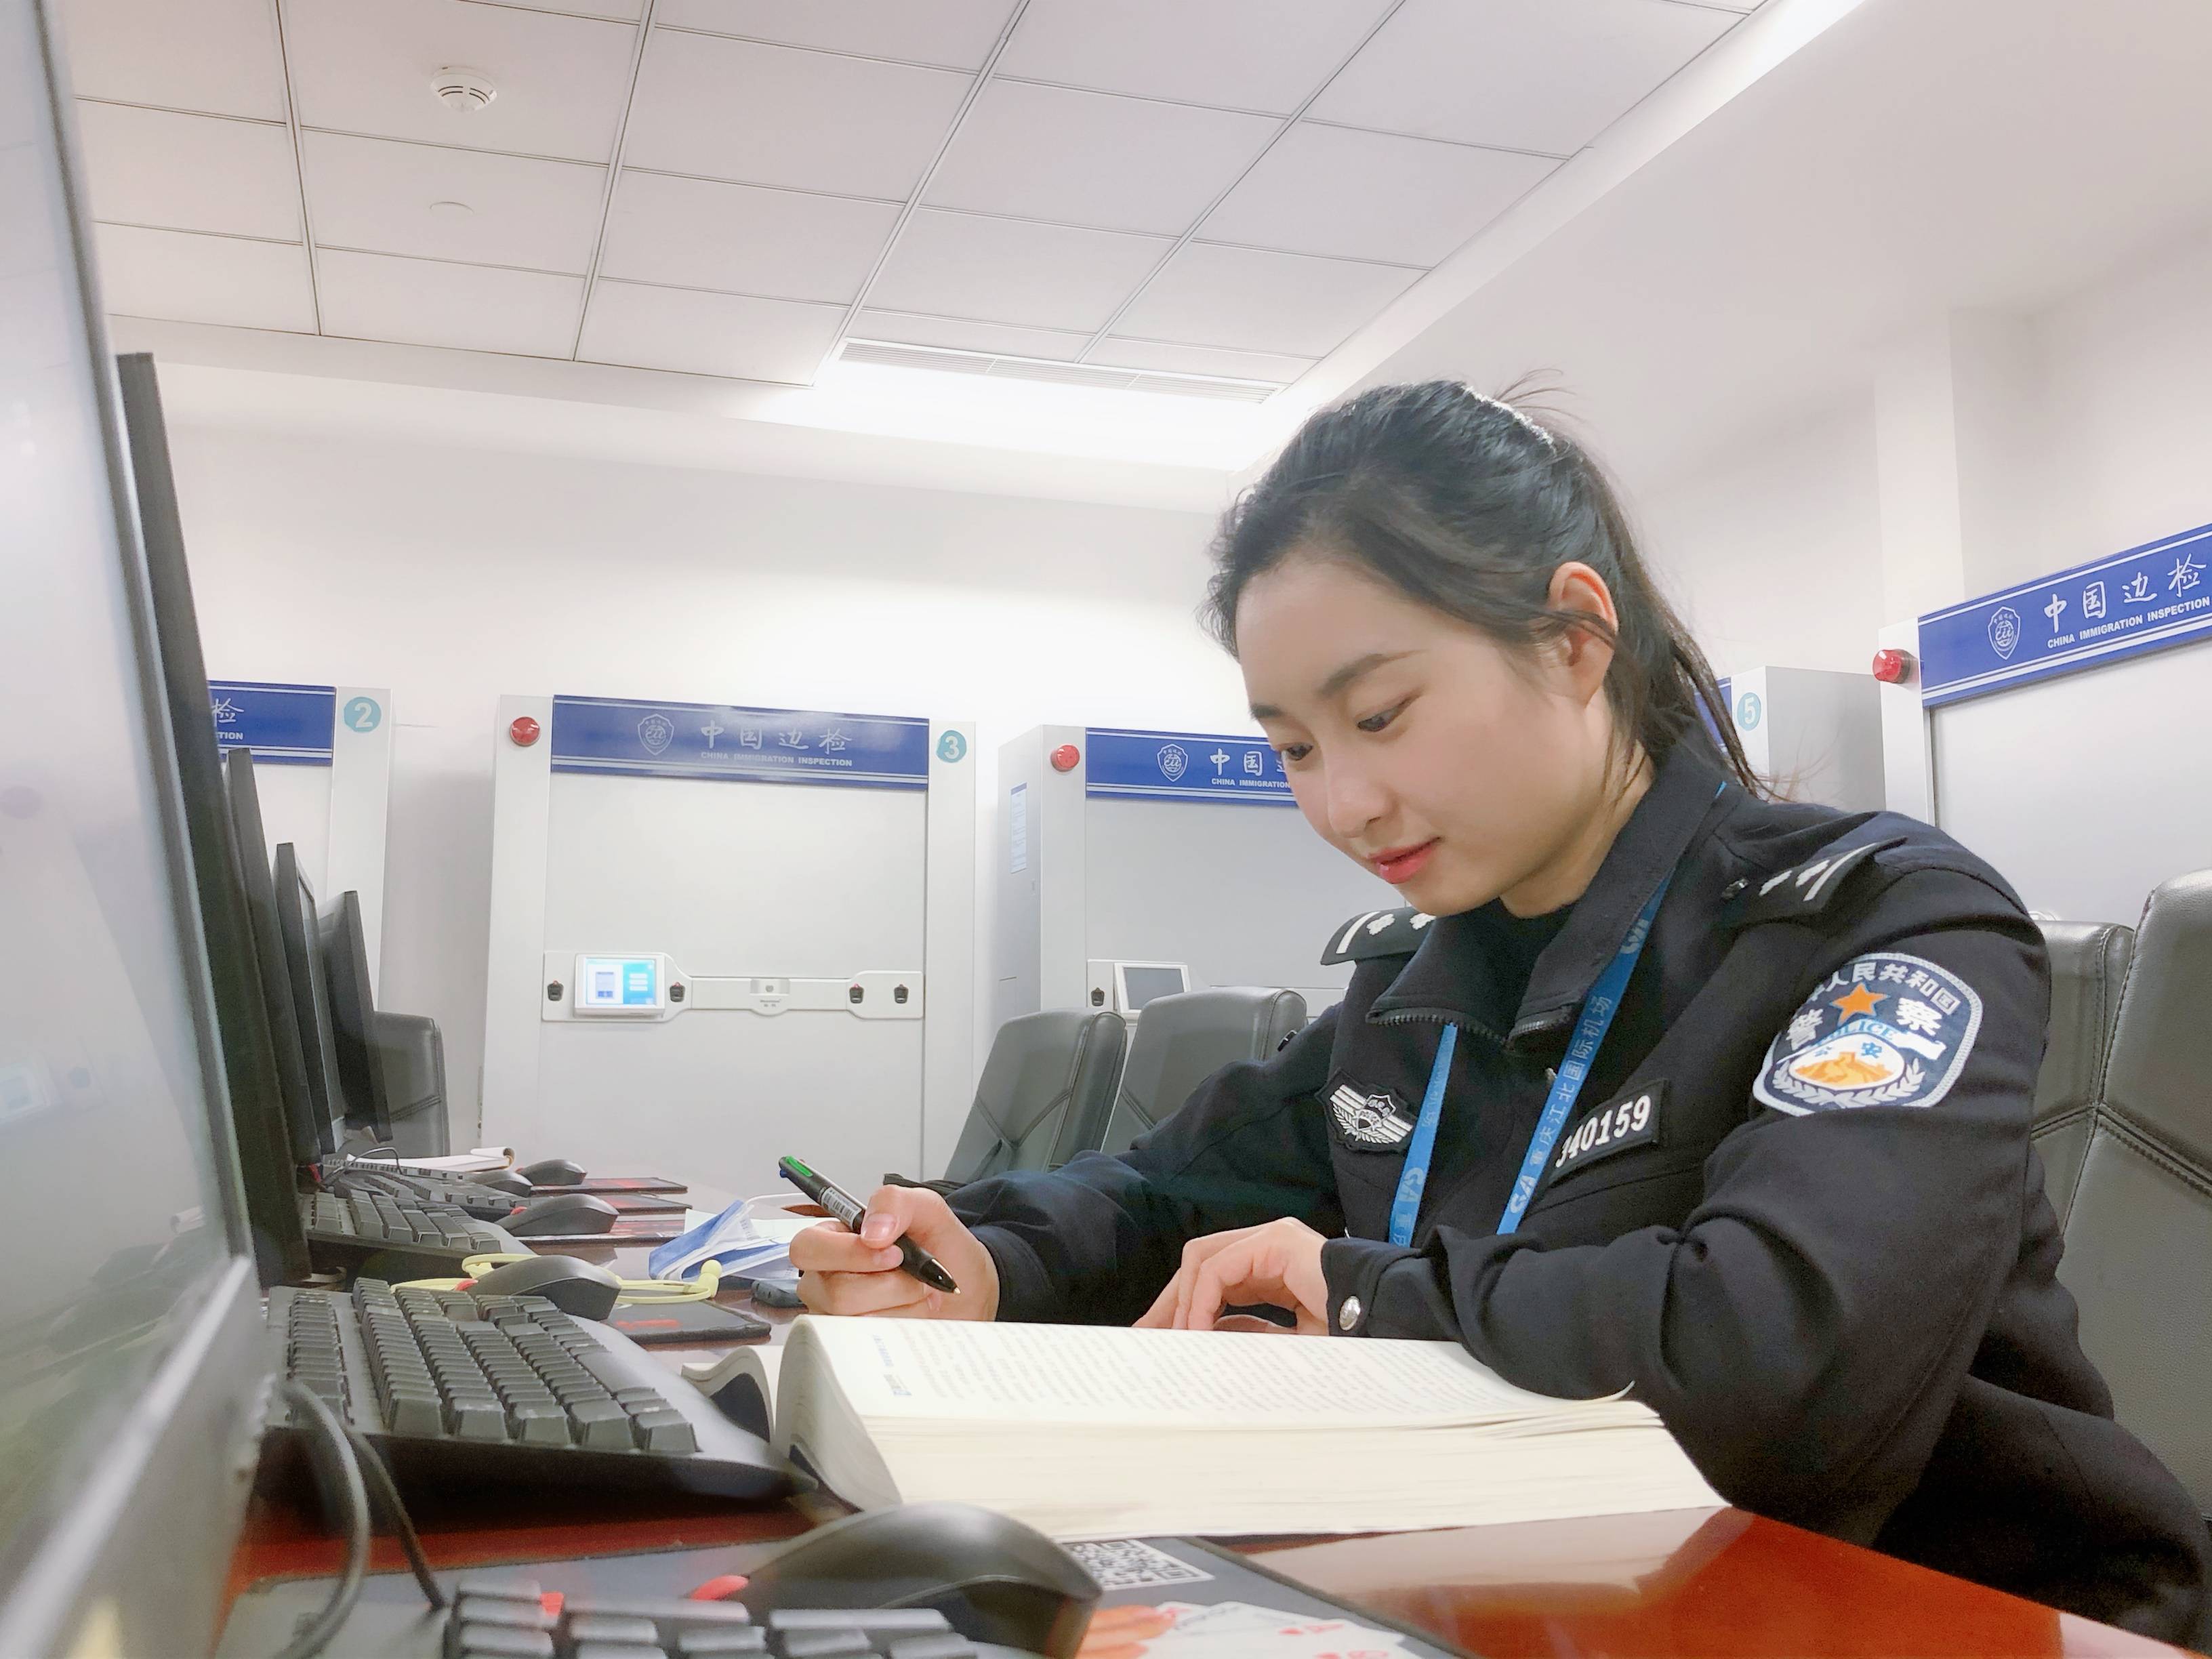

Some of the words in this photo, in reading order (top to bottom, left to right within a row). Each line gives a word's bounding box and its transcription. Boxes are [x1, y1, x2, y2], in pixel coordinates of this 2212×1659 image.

[2043, 552, 2207, 634] 中国边检
[2047, 633, 2076, 649] CHINA
[2079, 614, 2143, 640] IMMIGRATION
[2147, 596, 2210, 622] INSPECTION
[354, 701, 374, 729] 2
[1744, 696, 1757, 724] 5
[700, 719, 853, 756] 中国边检
[943, 735, 960, 760] 3
[700, 751, 730, 760] CHINA
[733, 753, 794, 764] IMMIGRATION
[798, 756, 853, 767] INSPECTION
[1211, 778, 1235, 786] CHINA
[1239, 779, 1291, 789] IMMIGRATION
[1896, 997, 1943, 1037] 察
